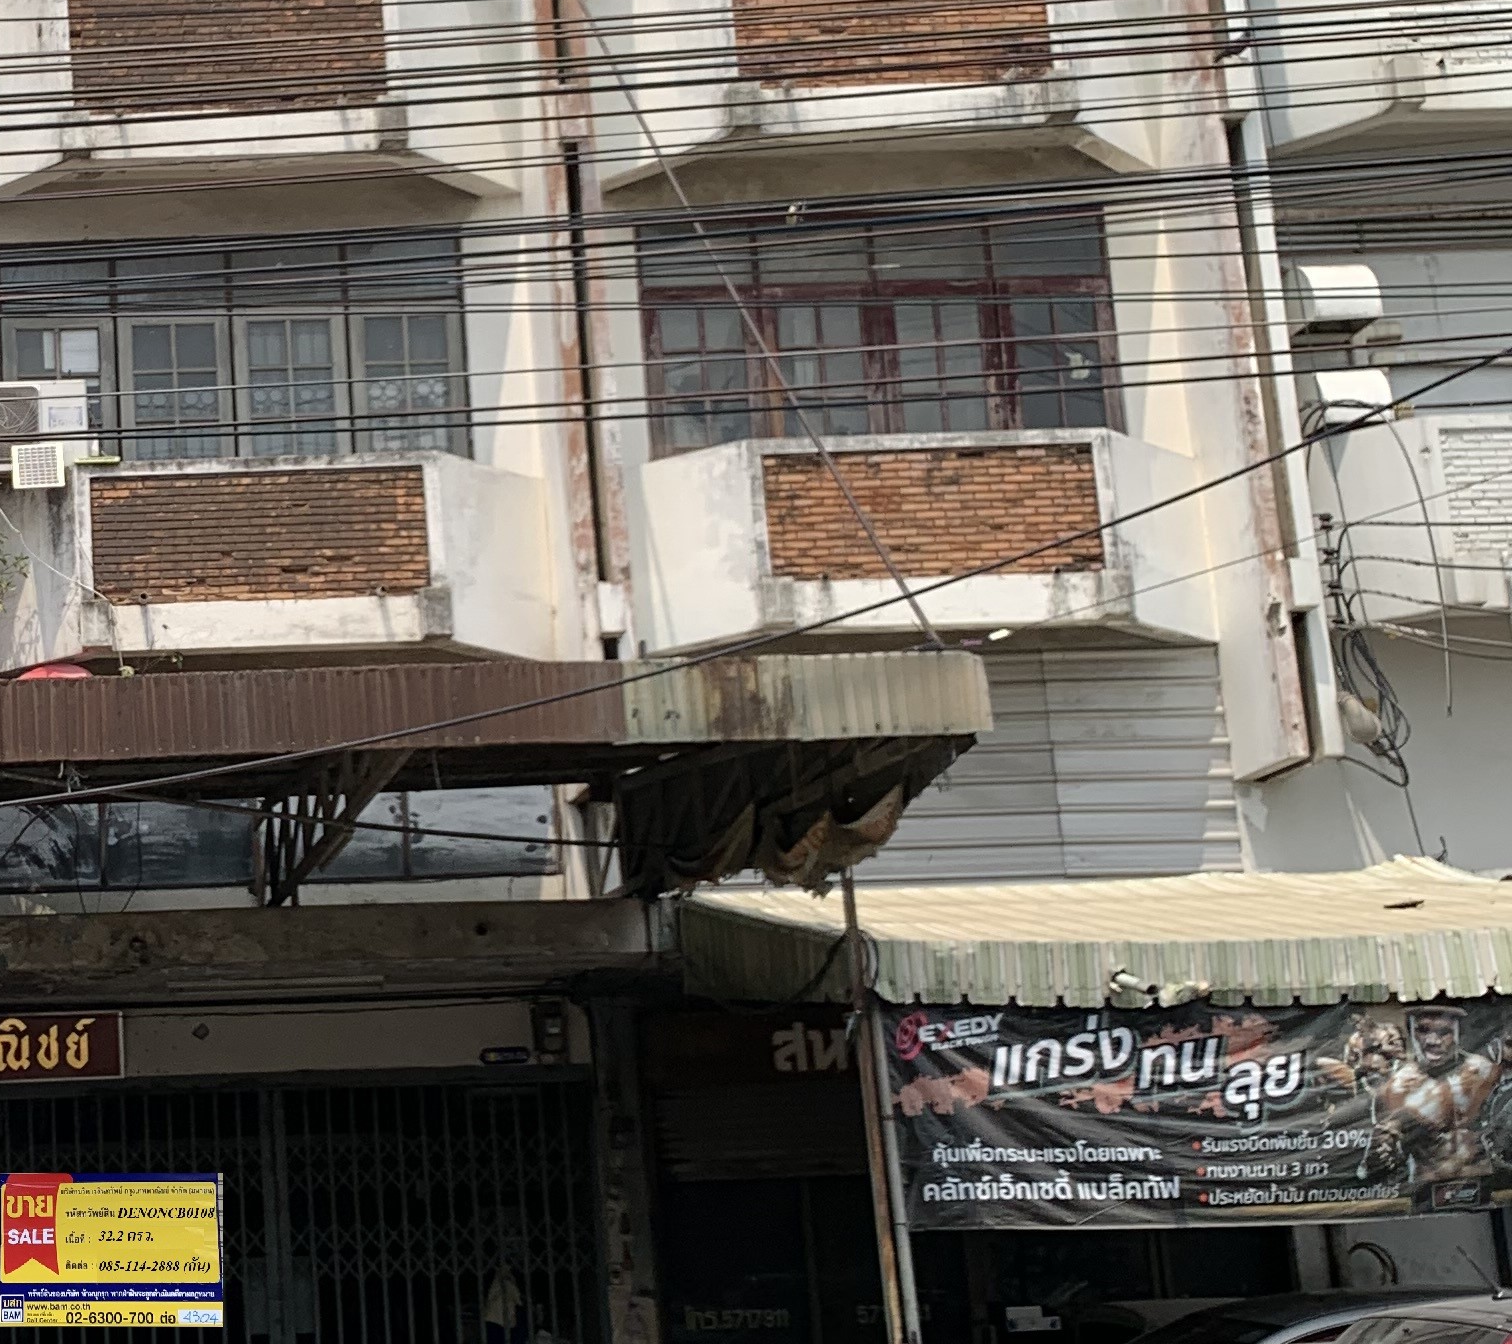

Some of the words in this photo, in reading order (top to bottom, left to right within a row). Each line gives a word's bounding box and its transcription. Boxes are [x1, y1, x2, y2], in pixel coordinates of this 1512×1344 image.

[918, 1013, 1004, 1043] EXEDY
[993, 1015, 1134, 1087] แกร่ง
[1139, 1037, 1218, 1090] ทน
[1224, 1052, 1303, 1121] ลุย
[1322, 1129, 1367, 1150] 30%
[1291, 1162, 1301, 1176] 3
[1076, 1172, 1181, 1201] แบล็คทัฟ
[6, 1194, 54, 1219] ขาย
[7, 1228, 55, 1245] SALE
[98, 1230, 124, 1242] 32.2
[99, 1260, 180, 1272] 085-114-2888
[26, 1303, 91, 1311] www.bam.co.th
[3, 1310, 21, 1320] BAM
[65, 1311, 154, 1324] 02-6300-700
[160, 1310, 176, 1324] ต่อ
